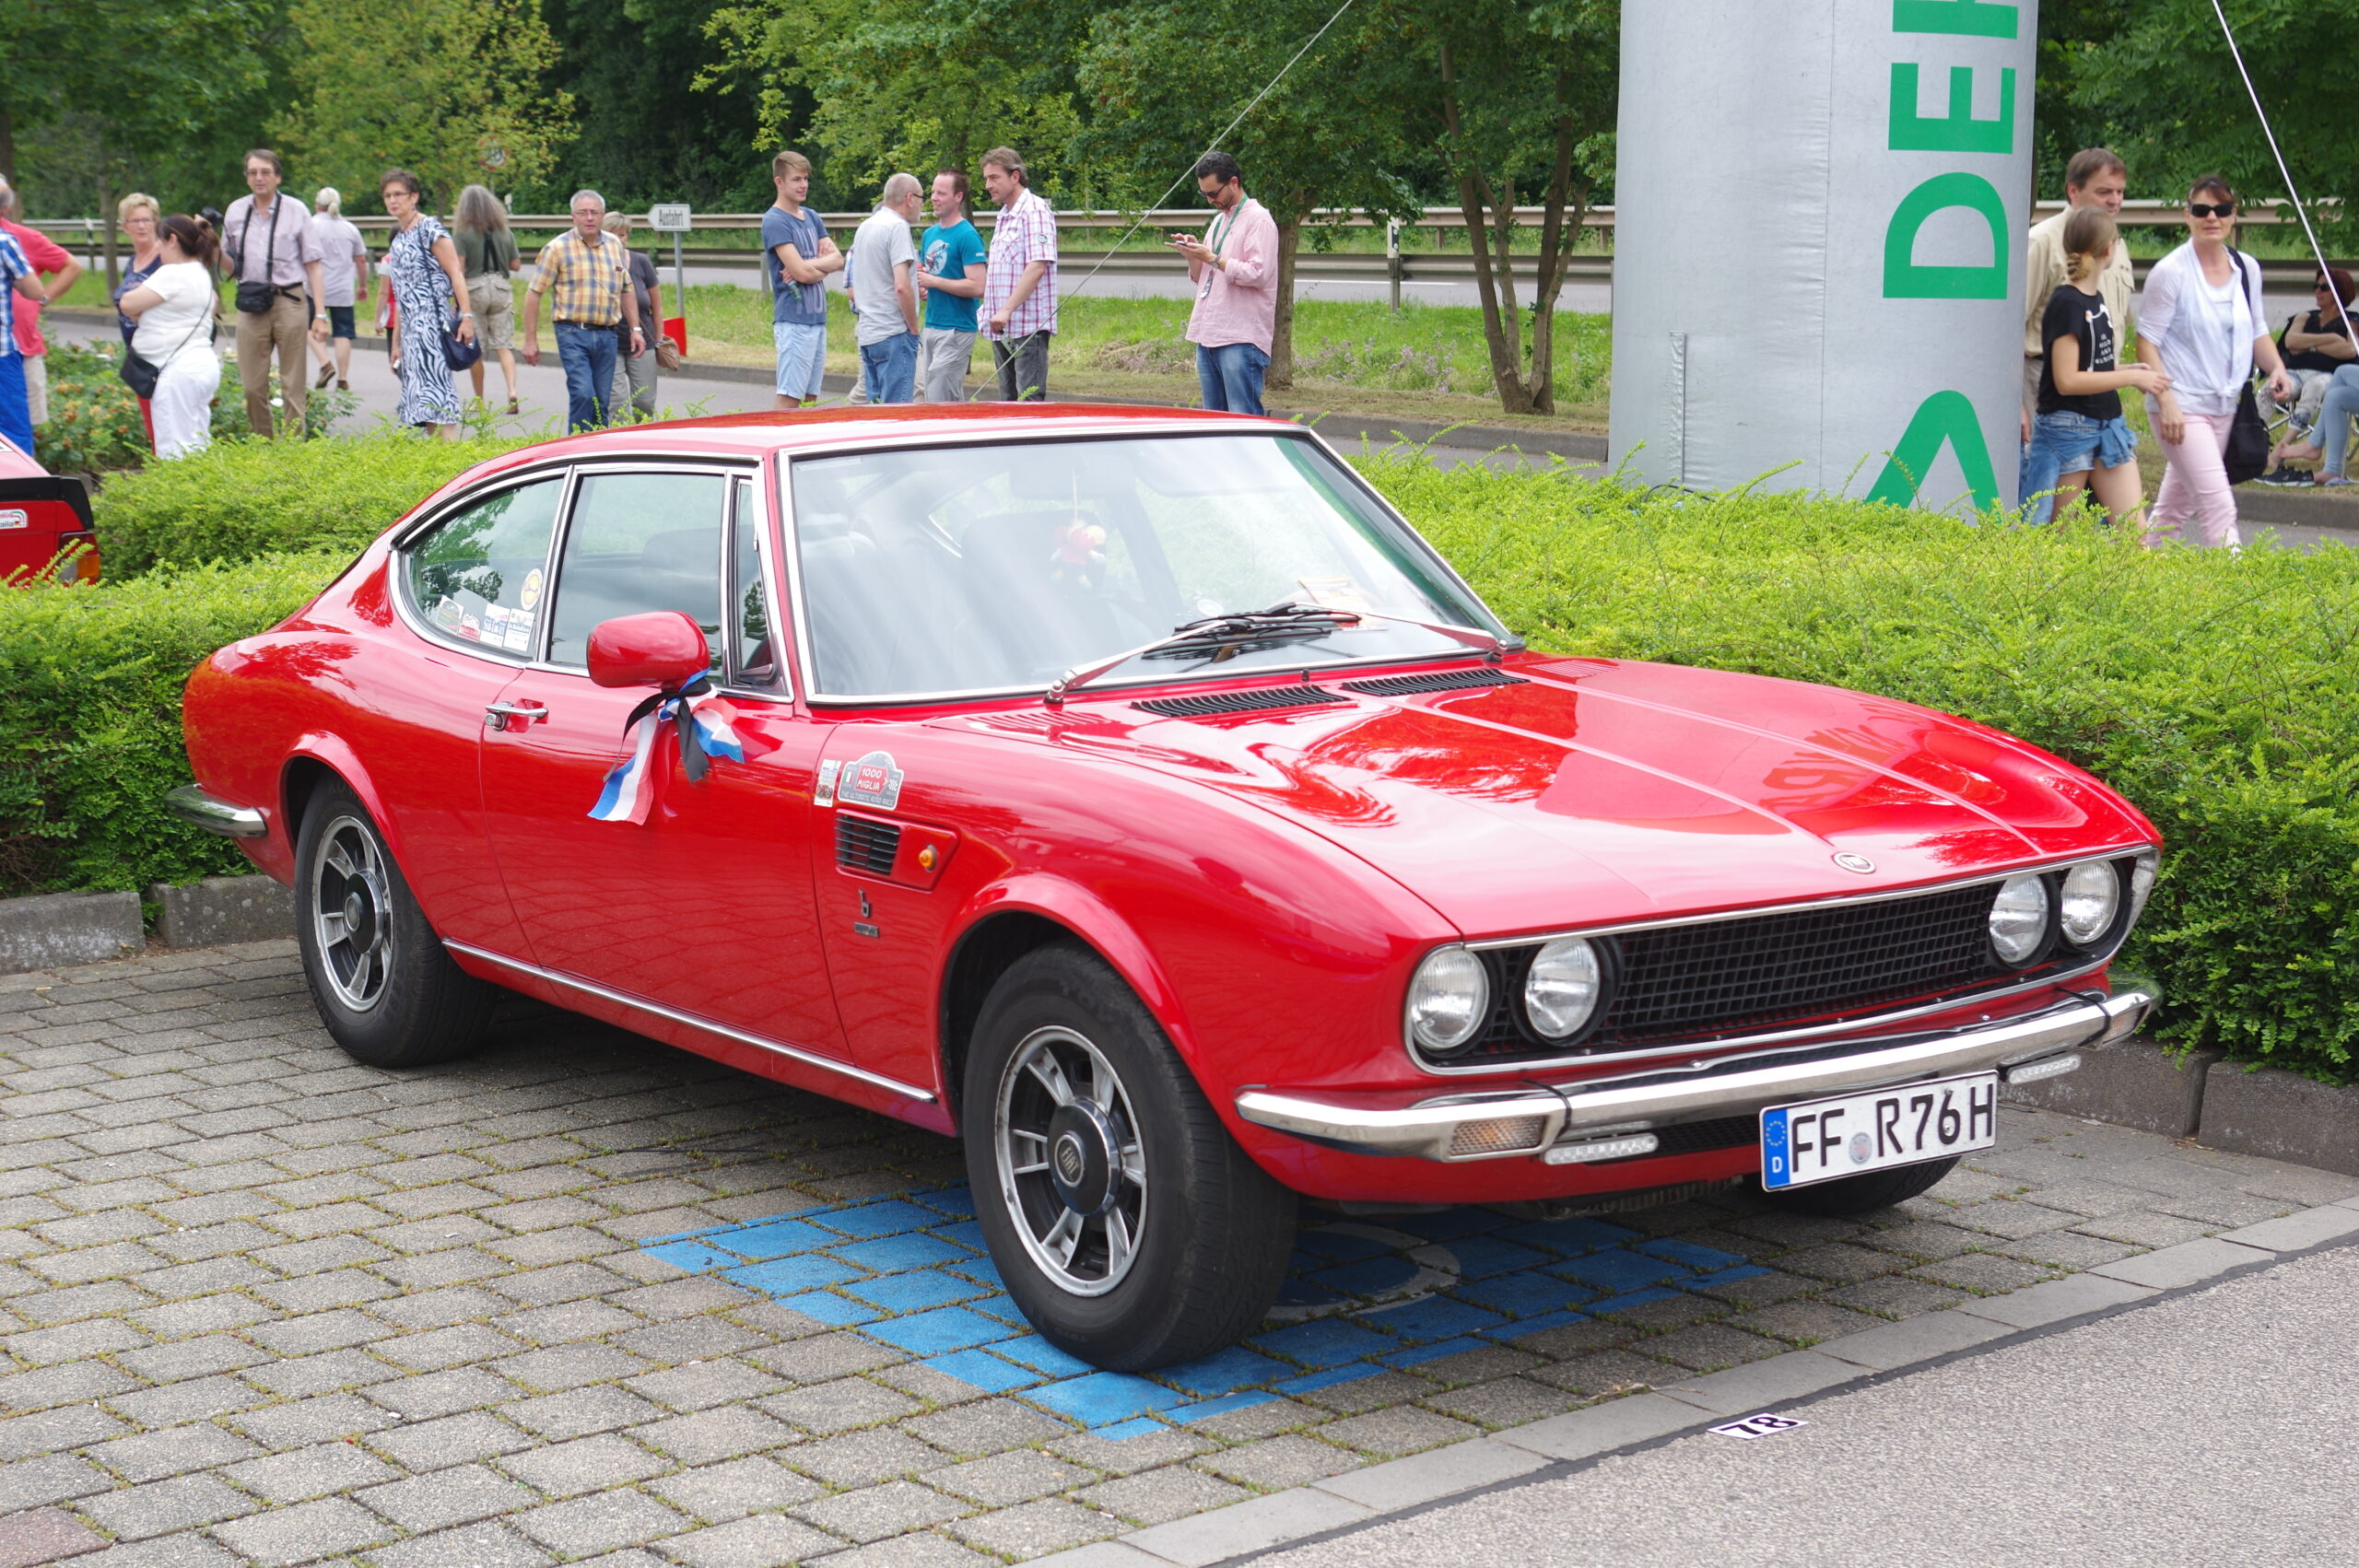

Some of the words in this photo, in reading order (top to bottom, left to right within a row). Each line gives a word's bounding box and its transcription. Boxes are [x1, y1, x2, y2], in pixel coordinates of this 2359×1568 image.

[658, 208, 684, 227] Ausfahrt
[862, 767, 882, 779] 1000
[856, 779, 880, 791] MIGLIA
[1791, 1108, 1845, 1173] FF
[1062, 1145, 1080, 1175] FIAT
[1771, 1156, 1783, 1174] D
[1718, 1416, 1799, 1435] 78
